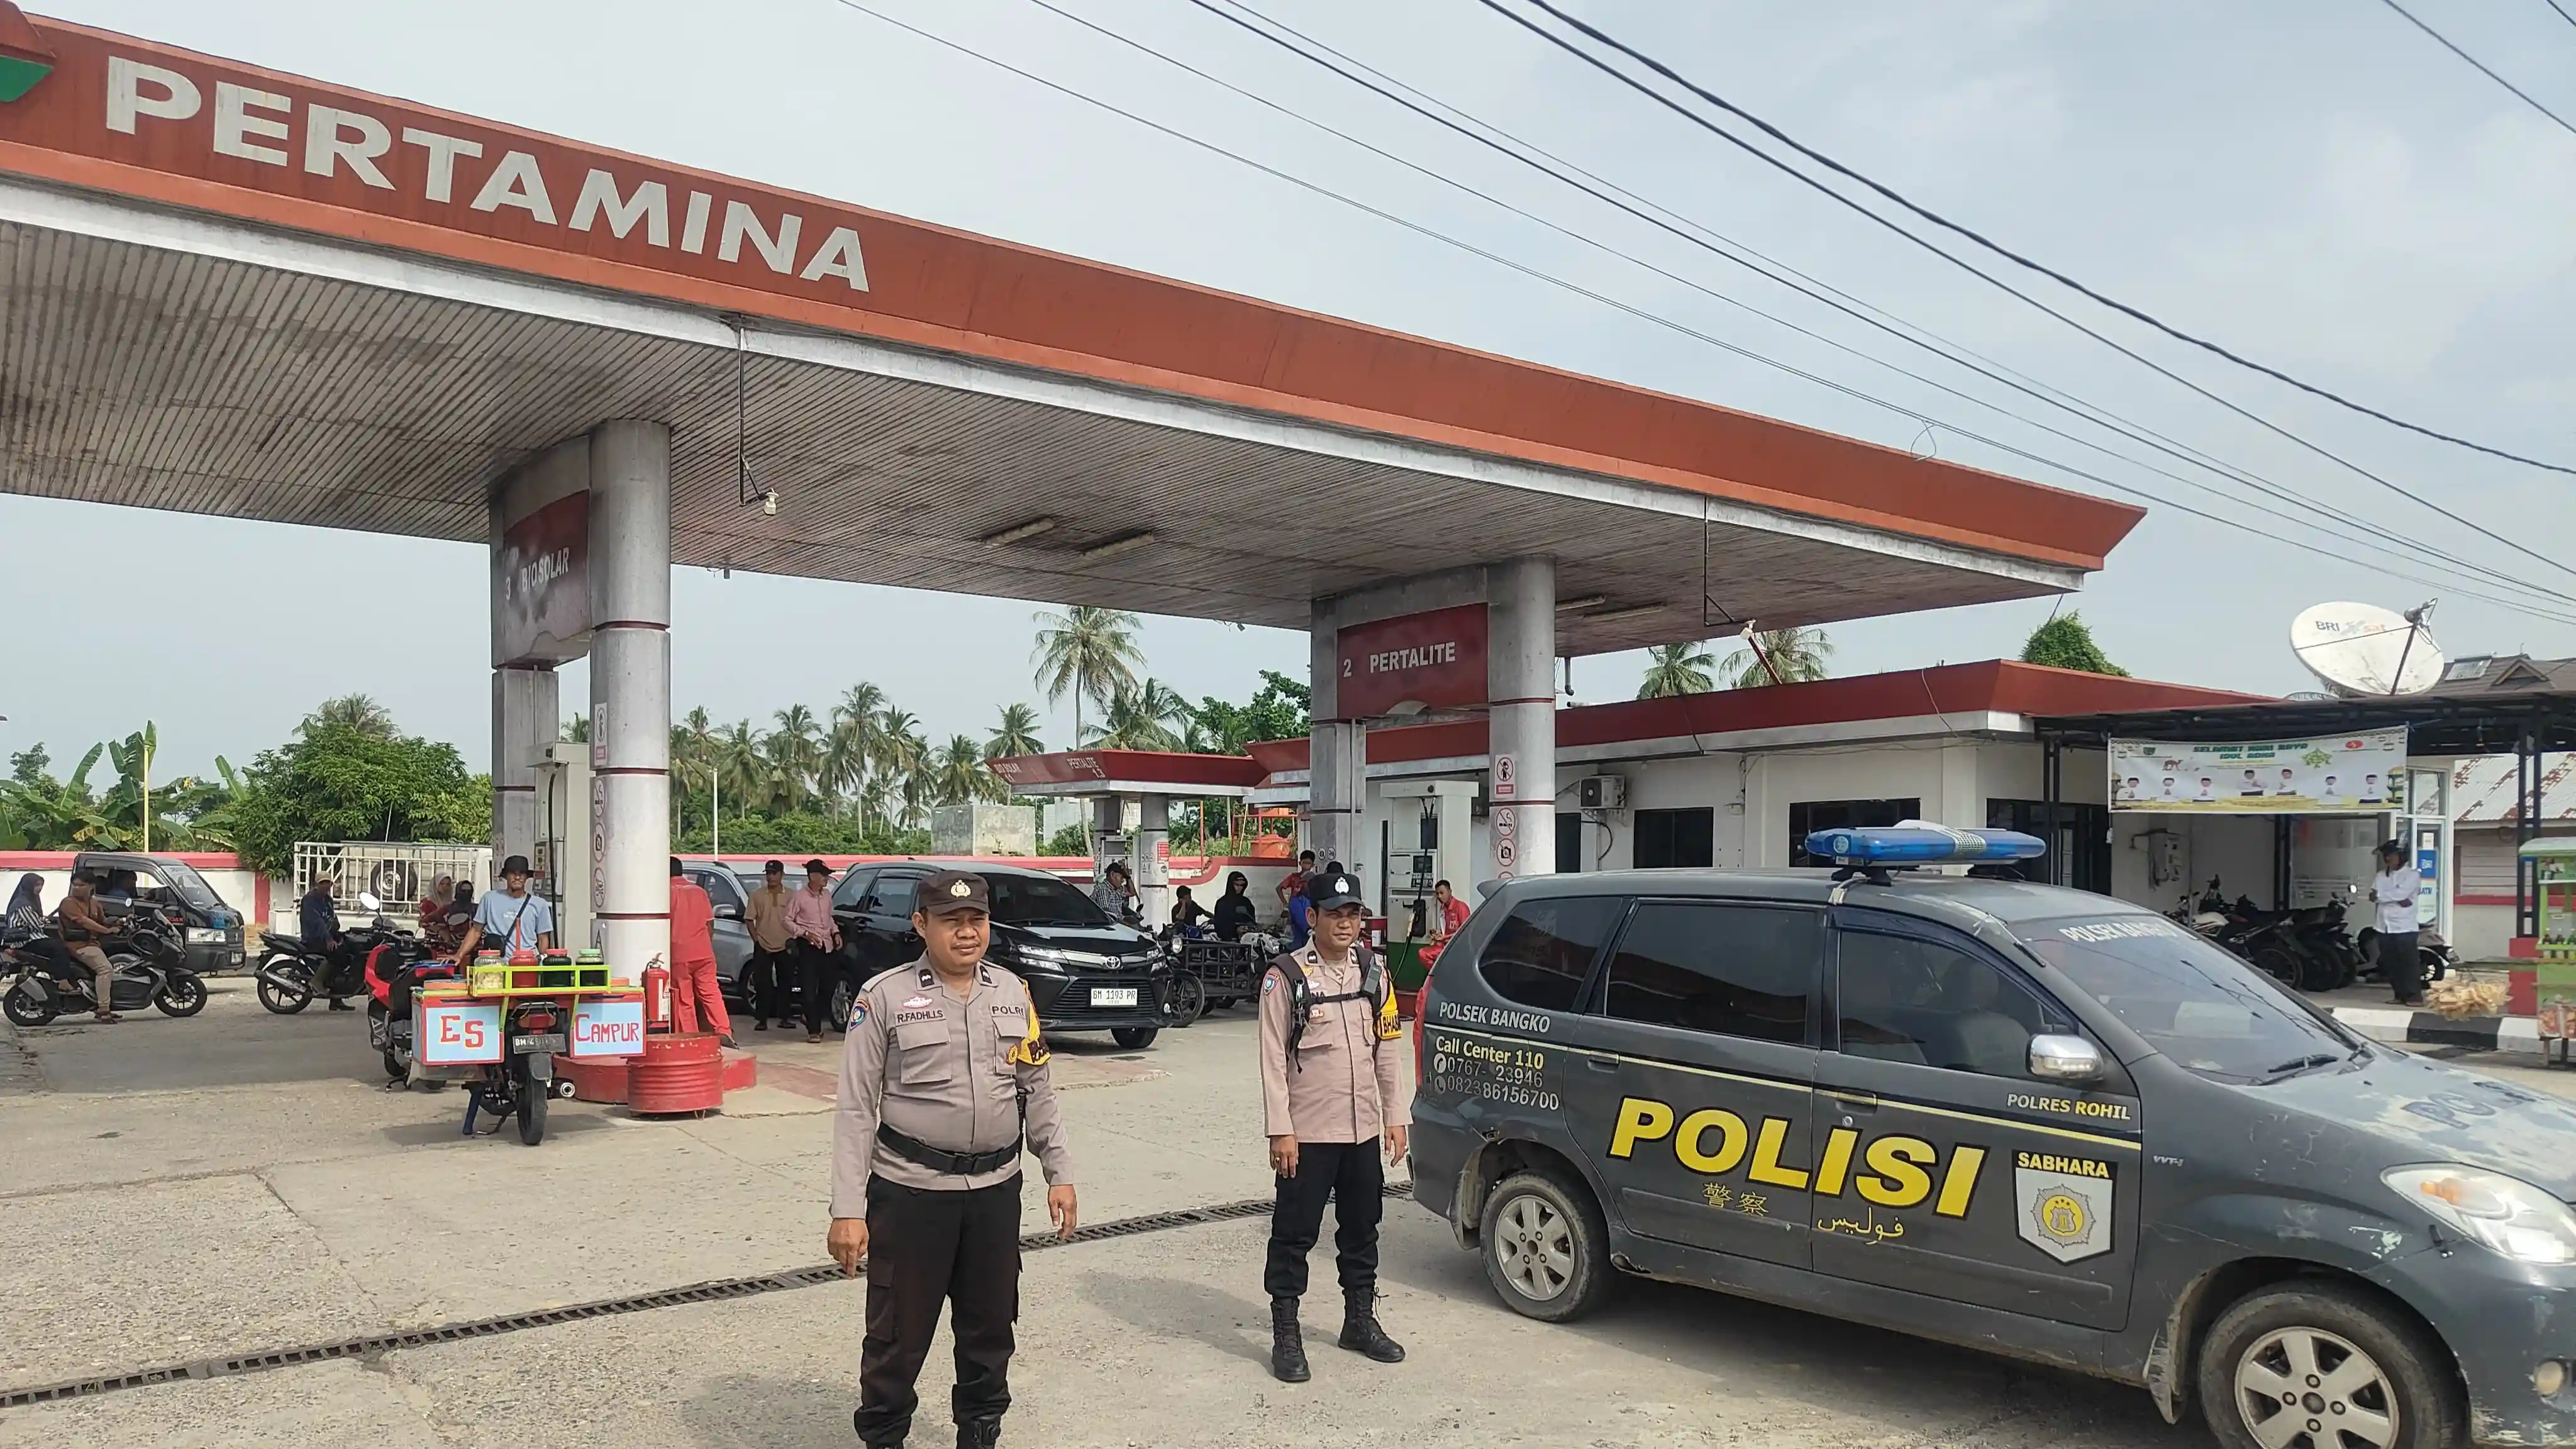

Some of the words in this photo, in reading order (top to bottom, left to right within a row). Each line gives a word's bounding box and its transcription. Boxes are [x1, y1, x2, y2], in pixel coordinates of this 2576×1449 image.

[105, 55, 870, 292] PERTAMINA
[506, 576, 511, 601] 3
[2316, 621, 2340, 631] BRI
[1343, 659, 1352, 678] 2
[1370, 641, 1456, 673] PERTALITE
[1067, 757, 1099, 769] PERTALITE
[2058, 923, 2127, 943] POLSEK
[1093, 989, 1102, 999] BM
[992, 1006, 1024, 1016] POLRI
[1439, 1001, 1489, 1024] POLSEK
[1490, 1008, 1551, 1033] BANGKO
[440, 1014, 484, 1048] ES
[575, 1013, 640, 1043] CAMPUR
[1436, 1035, 1460, 1055] Call
[1463, 1040, 1511, 1064] Center
[1515, 1049, 1545, 1070] 110
[1496, 1064, 1543, 1088] 23946
[1447, 1075, 1560, 1111] 082386156700
[2007, 1094, 2071, 1113] POLRES
[2075, 1101, 2132, 1121] ROHIL
[1608, 1096, 1987, 1218] POLISI
[2018, 1152, 2110, 1179] SABHARA
[1701, 1182, 1770, 1217] 警察
[1817, 1206, 1904, 1245] فوليس
